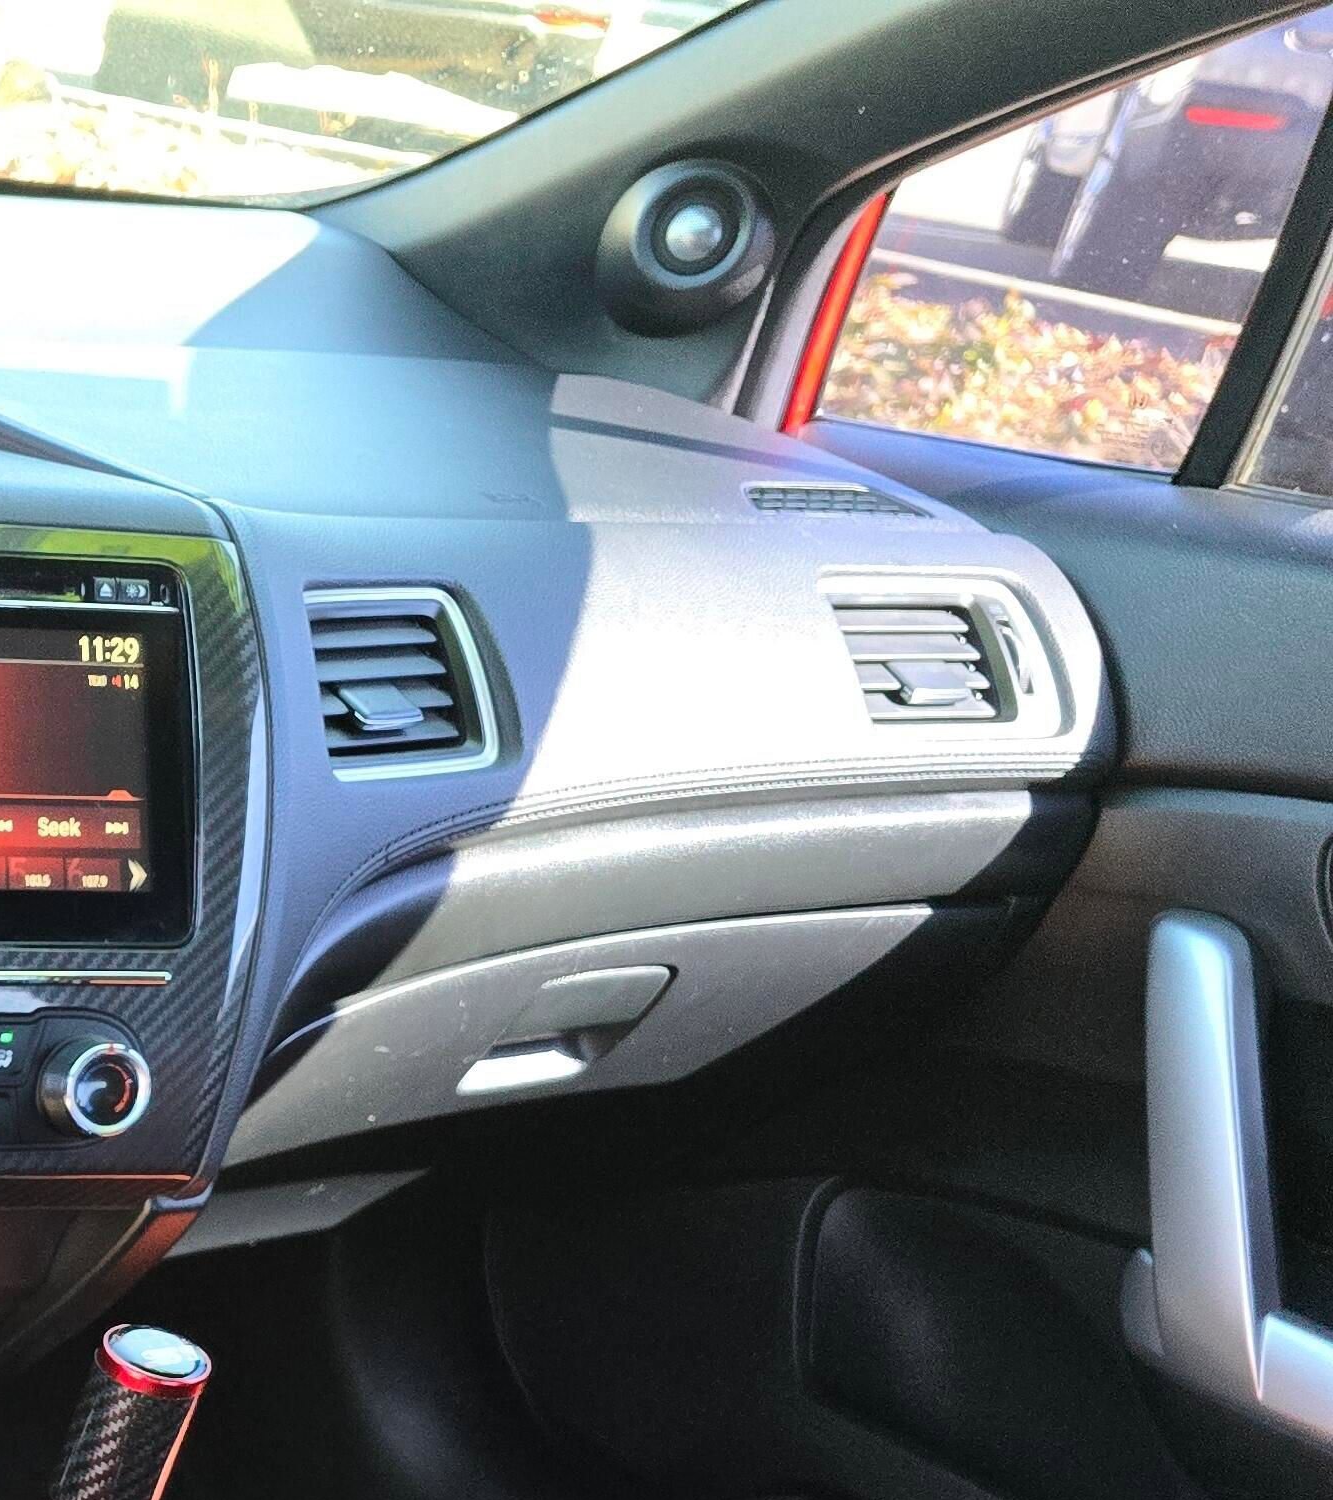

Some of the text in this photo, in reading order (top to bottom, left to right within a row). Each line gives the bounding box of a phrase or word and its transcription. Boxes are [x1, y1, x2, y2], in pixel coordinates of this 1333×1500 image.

[78, 635, 140, 663] 11:29
[123, 674, 139, 690] 14
[37, 816, 82, 838] Seek
